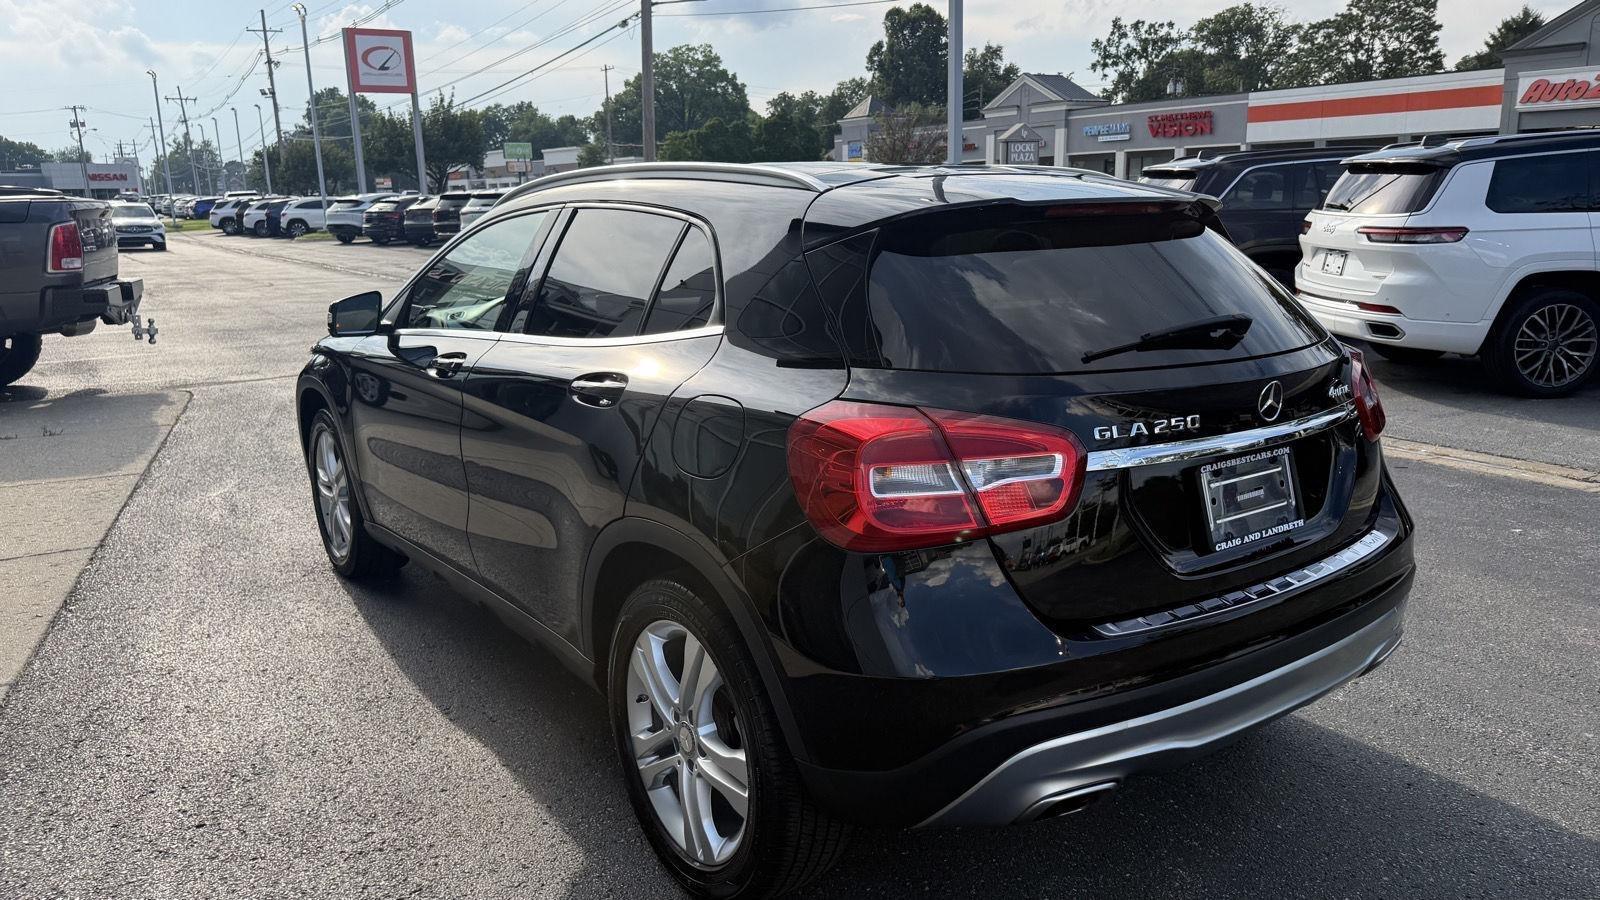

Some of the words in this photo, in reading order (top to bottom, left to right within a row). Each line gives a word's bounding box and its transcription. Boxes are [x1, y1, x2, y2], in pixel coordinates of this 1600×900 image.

[1148, 120, 1213, 137] VISION
[1011, 143, 1035, 152] LOCKE
[1011, 153, 1035, 162] PLAZA
[87, 173, 128, 181] NISSAN
[1093, 422, 1149, 440] GLA
[1153, 414, 1201, 434] 250
[1200, 446, 1290, 473] CRAIGSBESTCARS.COM
[1215, 538, 1242, 552] CRAIG
[1242, 532, 1261, 543] AND
[1262, 518, 1304, 537] LANDRETH
